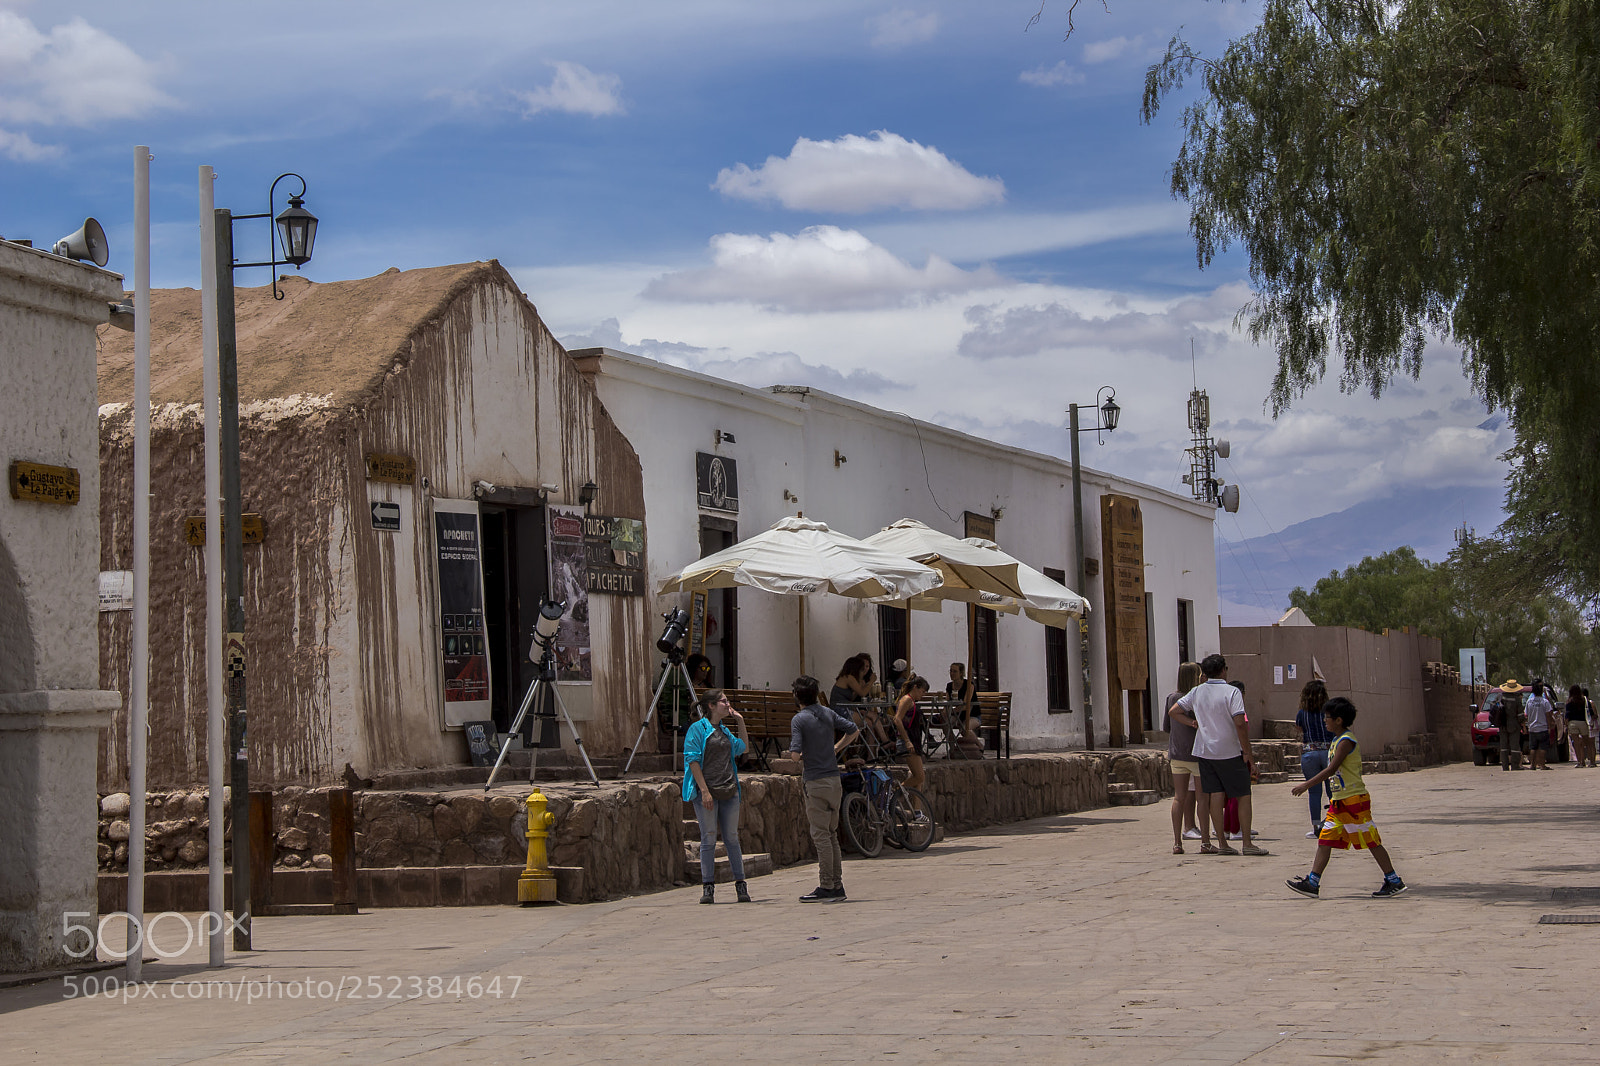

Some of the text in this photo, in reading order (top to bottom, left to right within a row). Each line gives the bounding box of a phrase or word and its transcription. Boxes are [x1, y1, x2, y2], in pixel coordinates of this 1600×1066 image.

[30, 469, 64, 485] Gustavo
[30, 482, 64, 500] Le Paige
